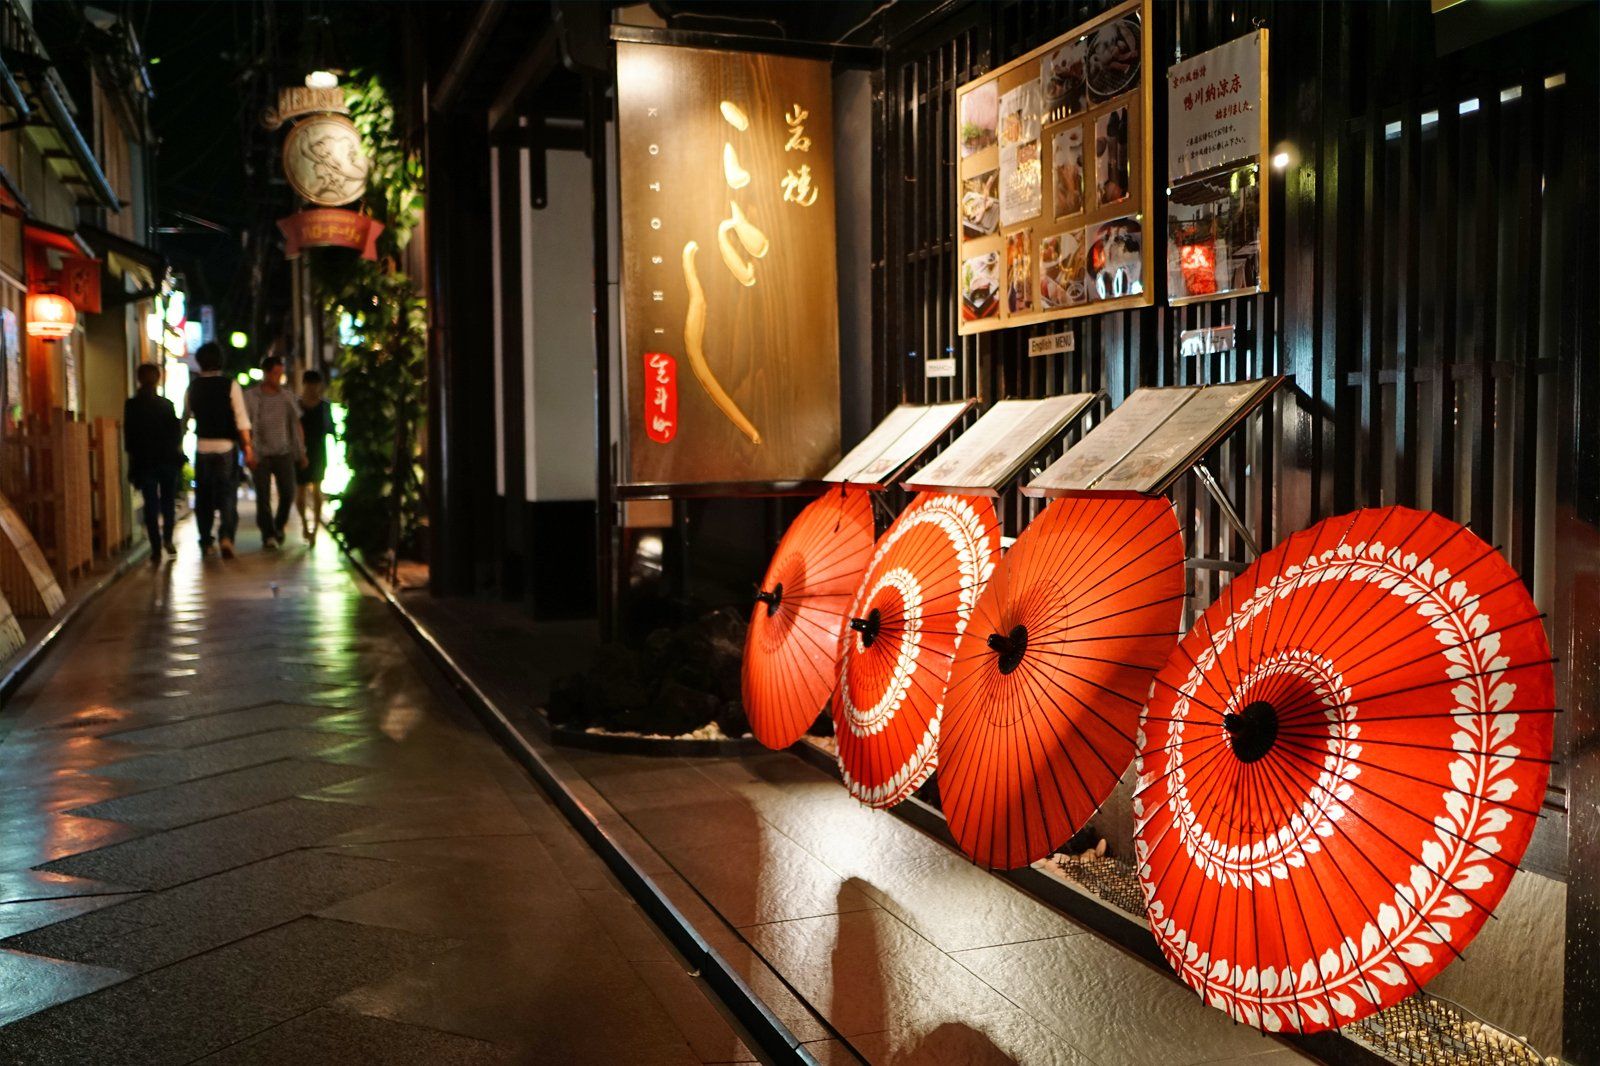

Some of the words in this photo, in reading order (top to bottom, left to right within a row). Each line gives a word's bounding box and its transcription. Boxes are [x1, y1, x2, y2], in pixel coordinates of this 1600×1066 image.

[1183, 73, 1242, 112] 鴨川納涼床
[646, 105, 666, 335] KOTOSHI
